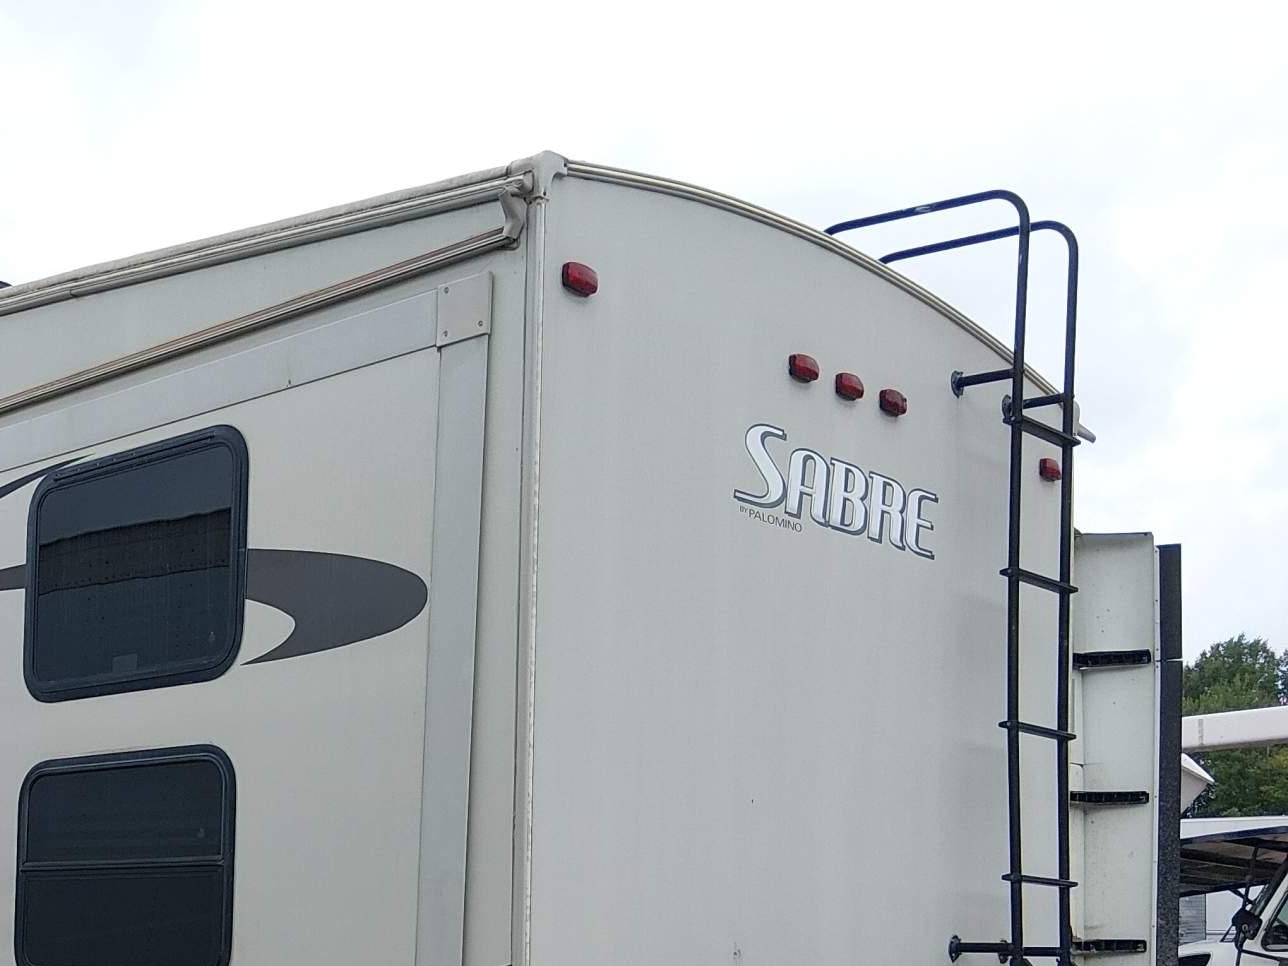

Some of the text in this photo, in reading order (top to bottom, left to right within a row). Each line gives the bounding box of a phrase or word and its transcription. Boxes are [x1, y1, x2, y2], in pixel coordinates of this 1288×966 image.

[733, 423, 939, 560] SABRE
[739, 505, 802, 533] BY PALOMINO
